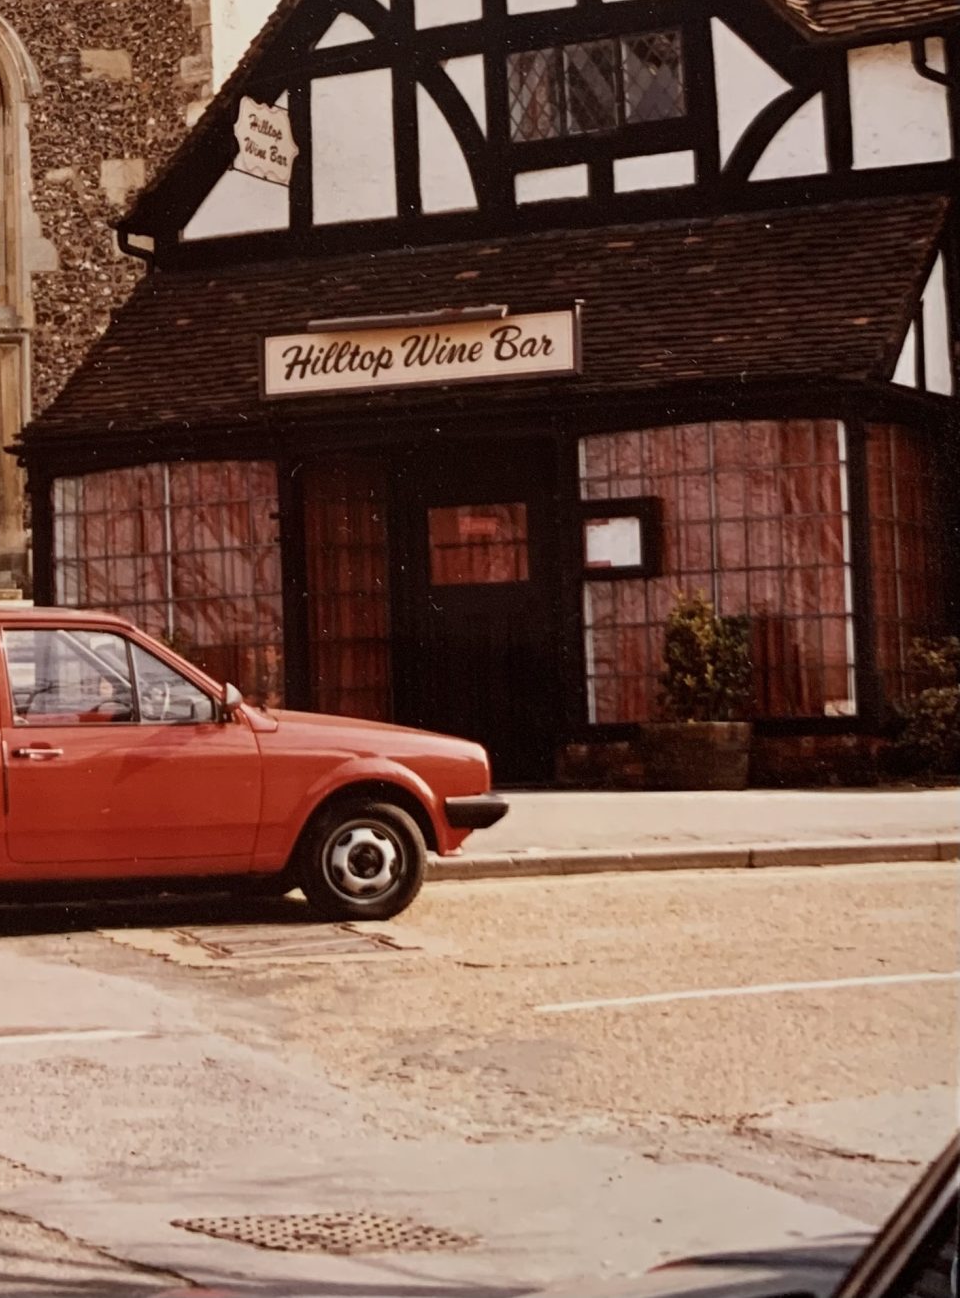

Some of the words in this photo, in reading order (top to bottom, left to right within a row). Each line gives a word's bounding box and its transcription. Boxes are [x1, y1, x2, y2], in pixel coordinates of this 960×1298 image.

[248, 113, 283, 142] Hilltop
[243, 136, 267, 160] Wine
[269, 145, 288, 167] Bar
[281, 340, 394, 381] Hilltop
[400, 332, 483, 368] Wine
[489, 325, 554, 361] Bar
